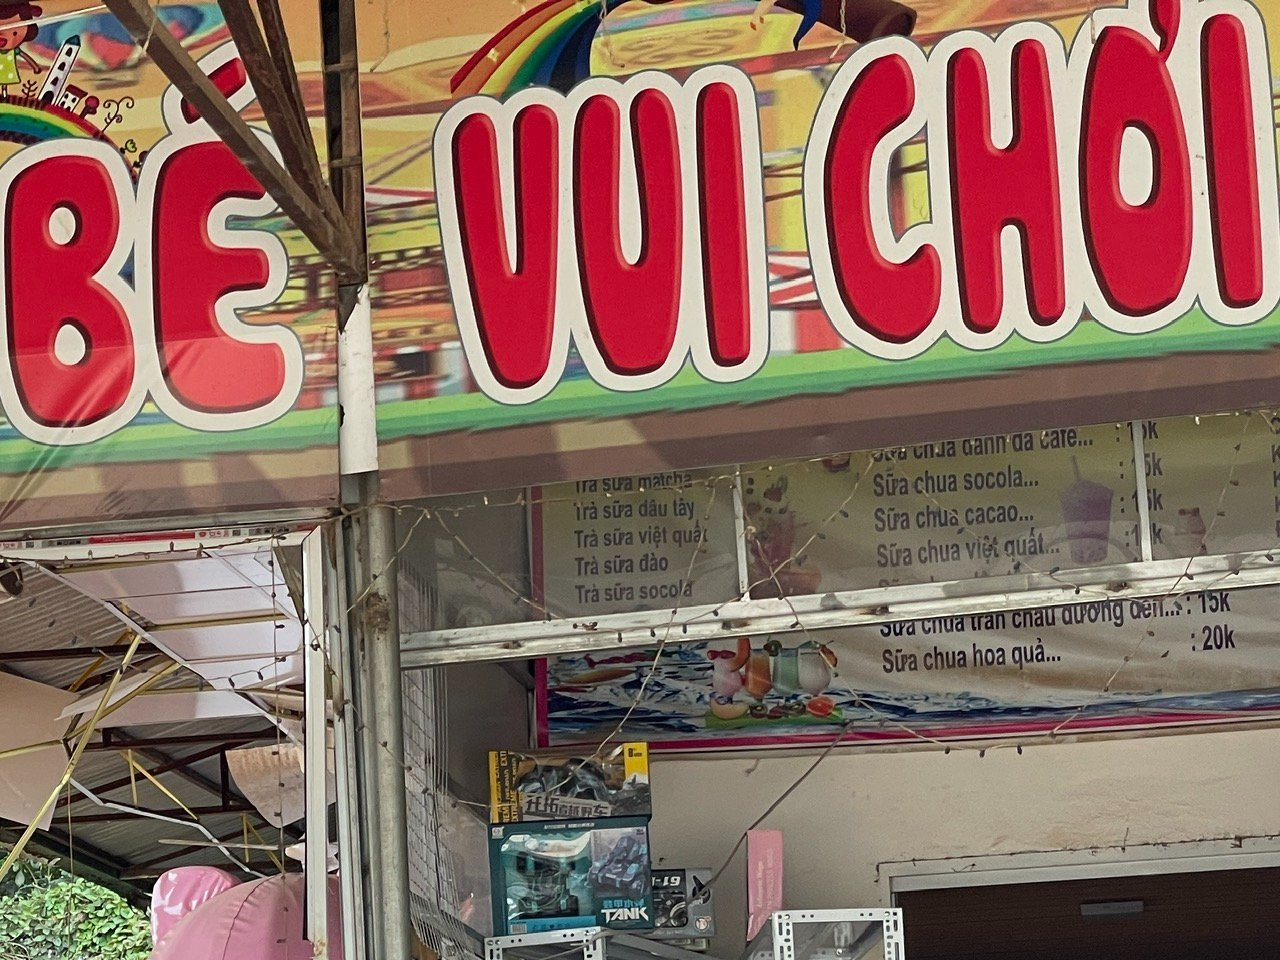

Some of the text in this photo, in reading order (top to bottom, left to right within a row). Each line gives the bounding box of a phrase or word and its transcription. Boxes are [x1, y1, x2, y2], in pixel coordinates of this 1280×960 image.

[452, 0, 1264, 389] VUI CHƠI
[6, 56, 287, 428] BÉ
[873, 472, 909, 497] Sữa
[914, 470, 958, 494] chua
[603, 501, 633, 519] sữa
[874, 507, 911, 532] Sữa
[916, 505, 959, 529] chua
[574, 529, 599, 548] Trà
[603, 528, 634, 547] sữa
[638, 526, 668, 548] việt
[575, 552, 669, 576] Trà sữa đào
[876, 543, 912, 568] Sữa
[918, 539, 961, 564] chua
[965, 535, 1000, 564] việt
[575, 580, 694, 603] Trà sữa socola
[882, 624, 1236, 674] Sữa chua hoa quả... 20k
[601, 906, 649, 924] TANK
